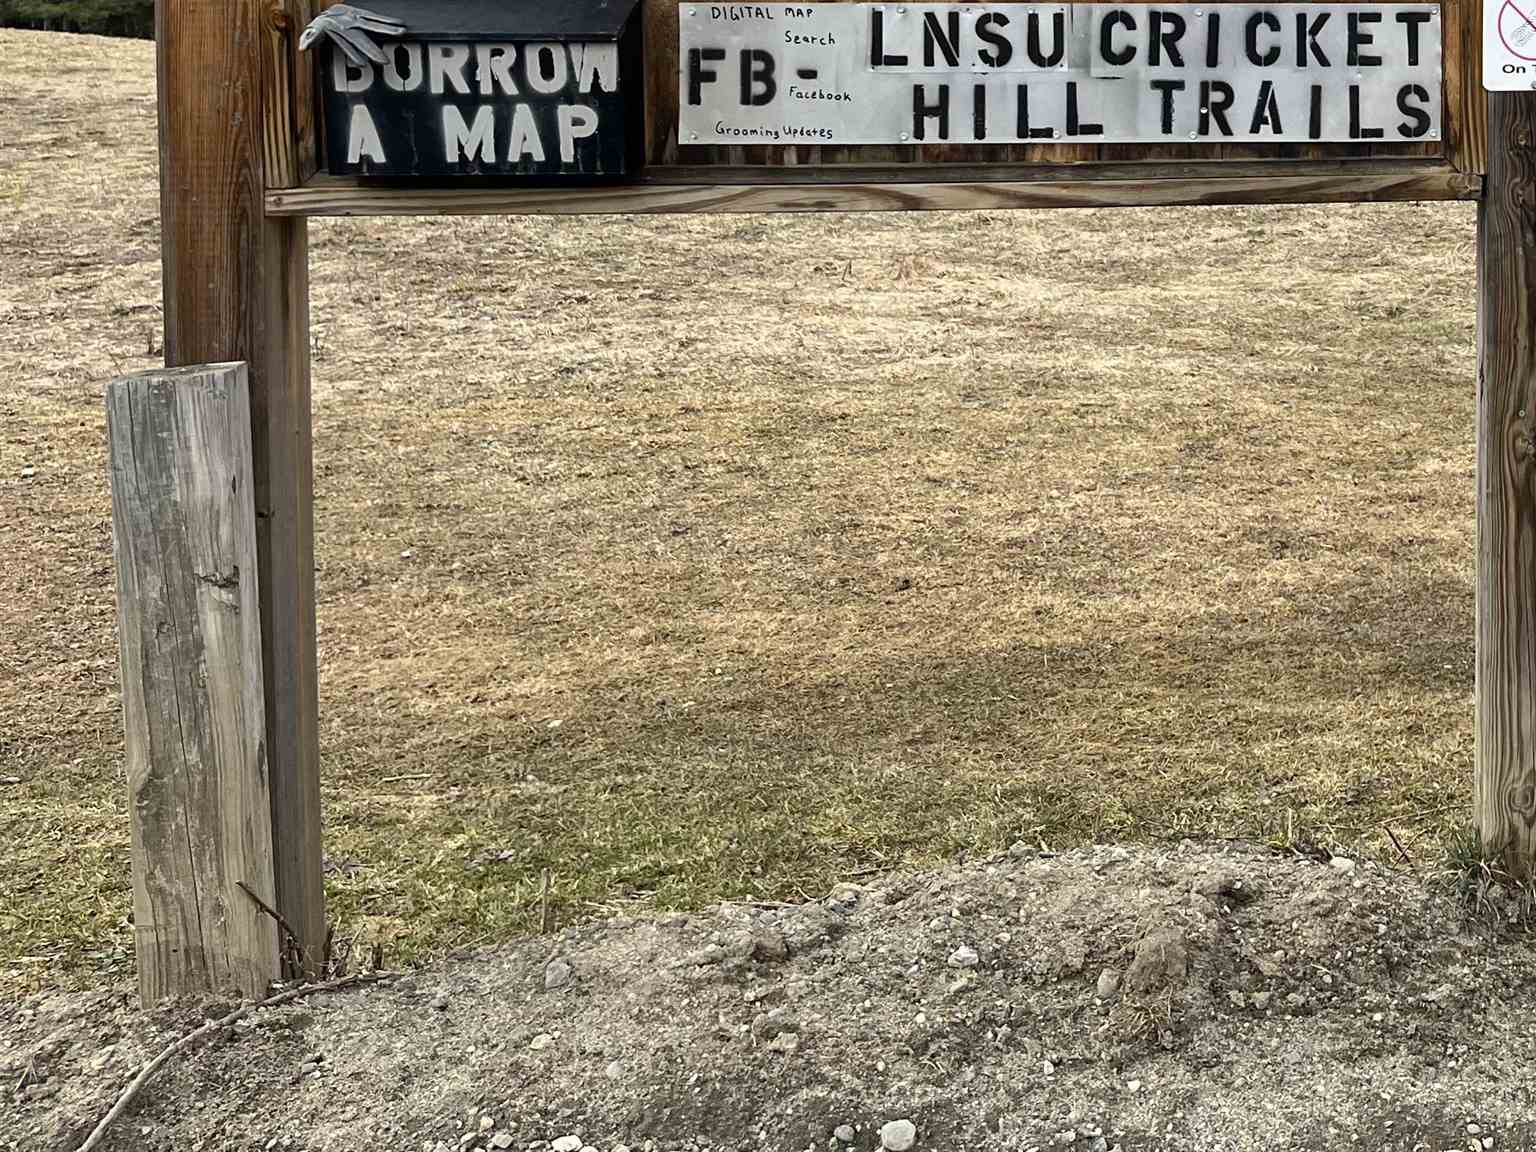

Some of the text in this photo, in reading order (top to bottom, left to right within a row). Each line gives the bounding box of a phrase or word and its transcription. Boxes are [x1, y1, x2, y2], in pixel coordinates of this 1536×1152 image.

[711, 6, 813, 20] DIGITAL MAP
[784, 30, 835, 46] Search
[870, 8, 1431, 68] LNSU CRICKET
[333, 43, 618, 95] BORROW
[1502, 64, 1526, 74] On
[789, 86, 851, 101] Facebook
[912, 80, 1431, 140] HILL TRAILS
[347, 105, 599, 162] A MAP
[715, 121, 832, 139] Grooming Updates
